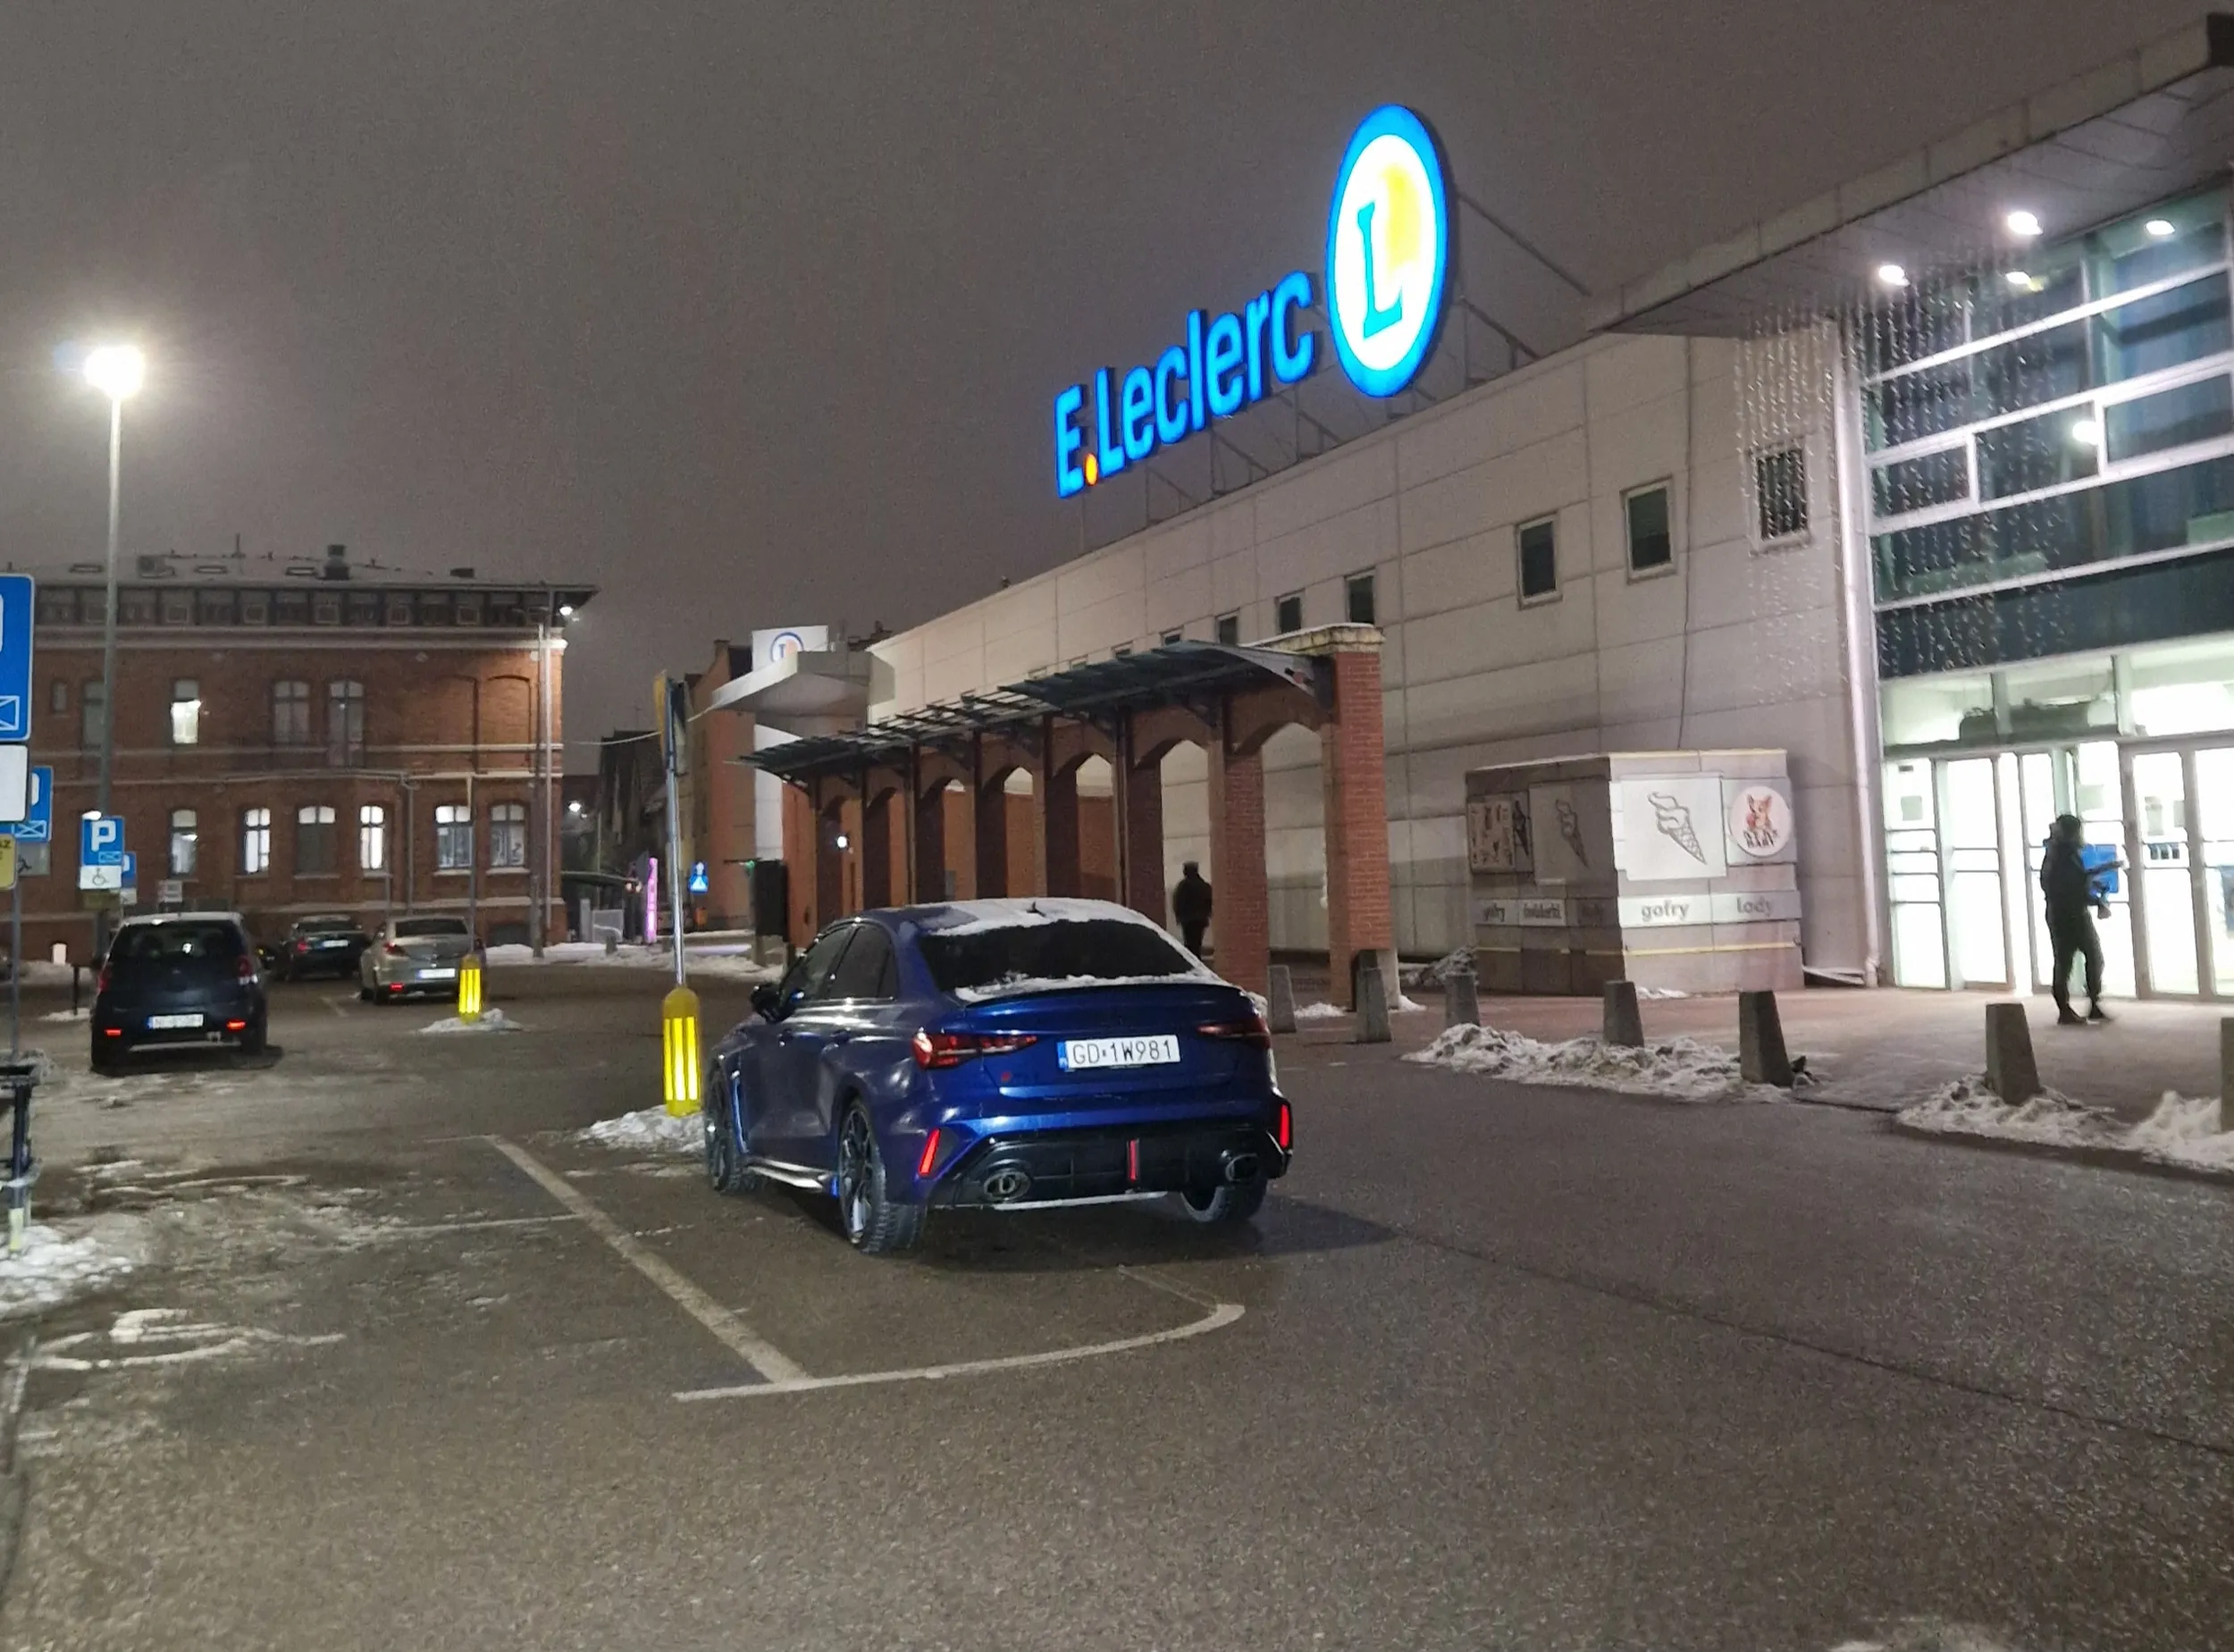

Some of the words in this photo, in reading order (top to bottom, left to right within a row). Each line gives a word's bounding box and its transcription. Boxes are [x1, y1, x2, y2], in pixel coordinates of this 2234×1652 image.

[1054, 270, 1315, 499] E.Leclerc
[90, 819, 116, 851] P
[1641, 900, 1691, 922] gofry
[1736, 896, 1774, 918] lody
